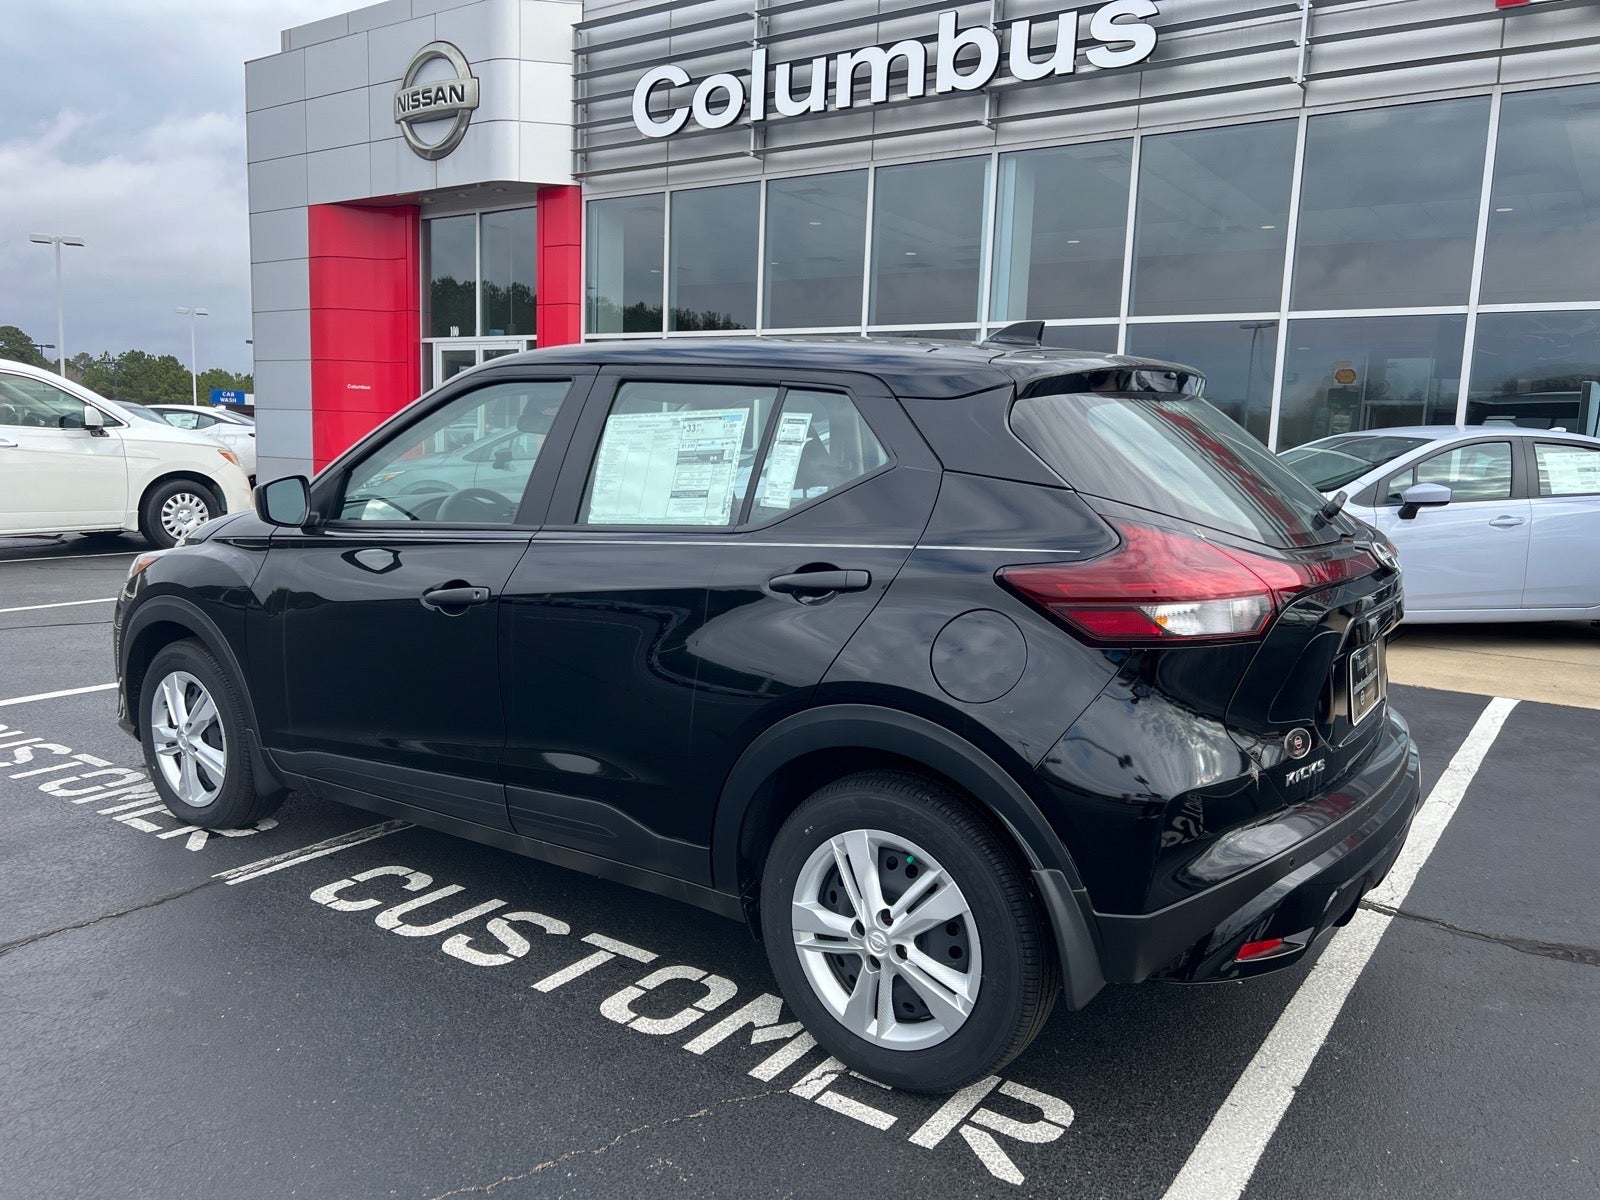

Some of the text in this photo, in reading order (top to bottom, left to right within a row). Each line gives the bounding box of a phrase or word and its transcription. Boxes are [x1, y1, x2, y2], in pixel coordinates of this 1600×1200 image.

[631, 0, 1160, 138] Columbus
[397, 83, 465, 114] NISSAN
[450, 325, 460, 337] 100
[686, 423, 697, 433] 33
[1285, 759, 1326, 787] KICKS
